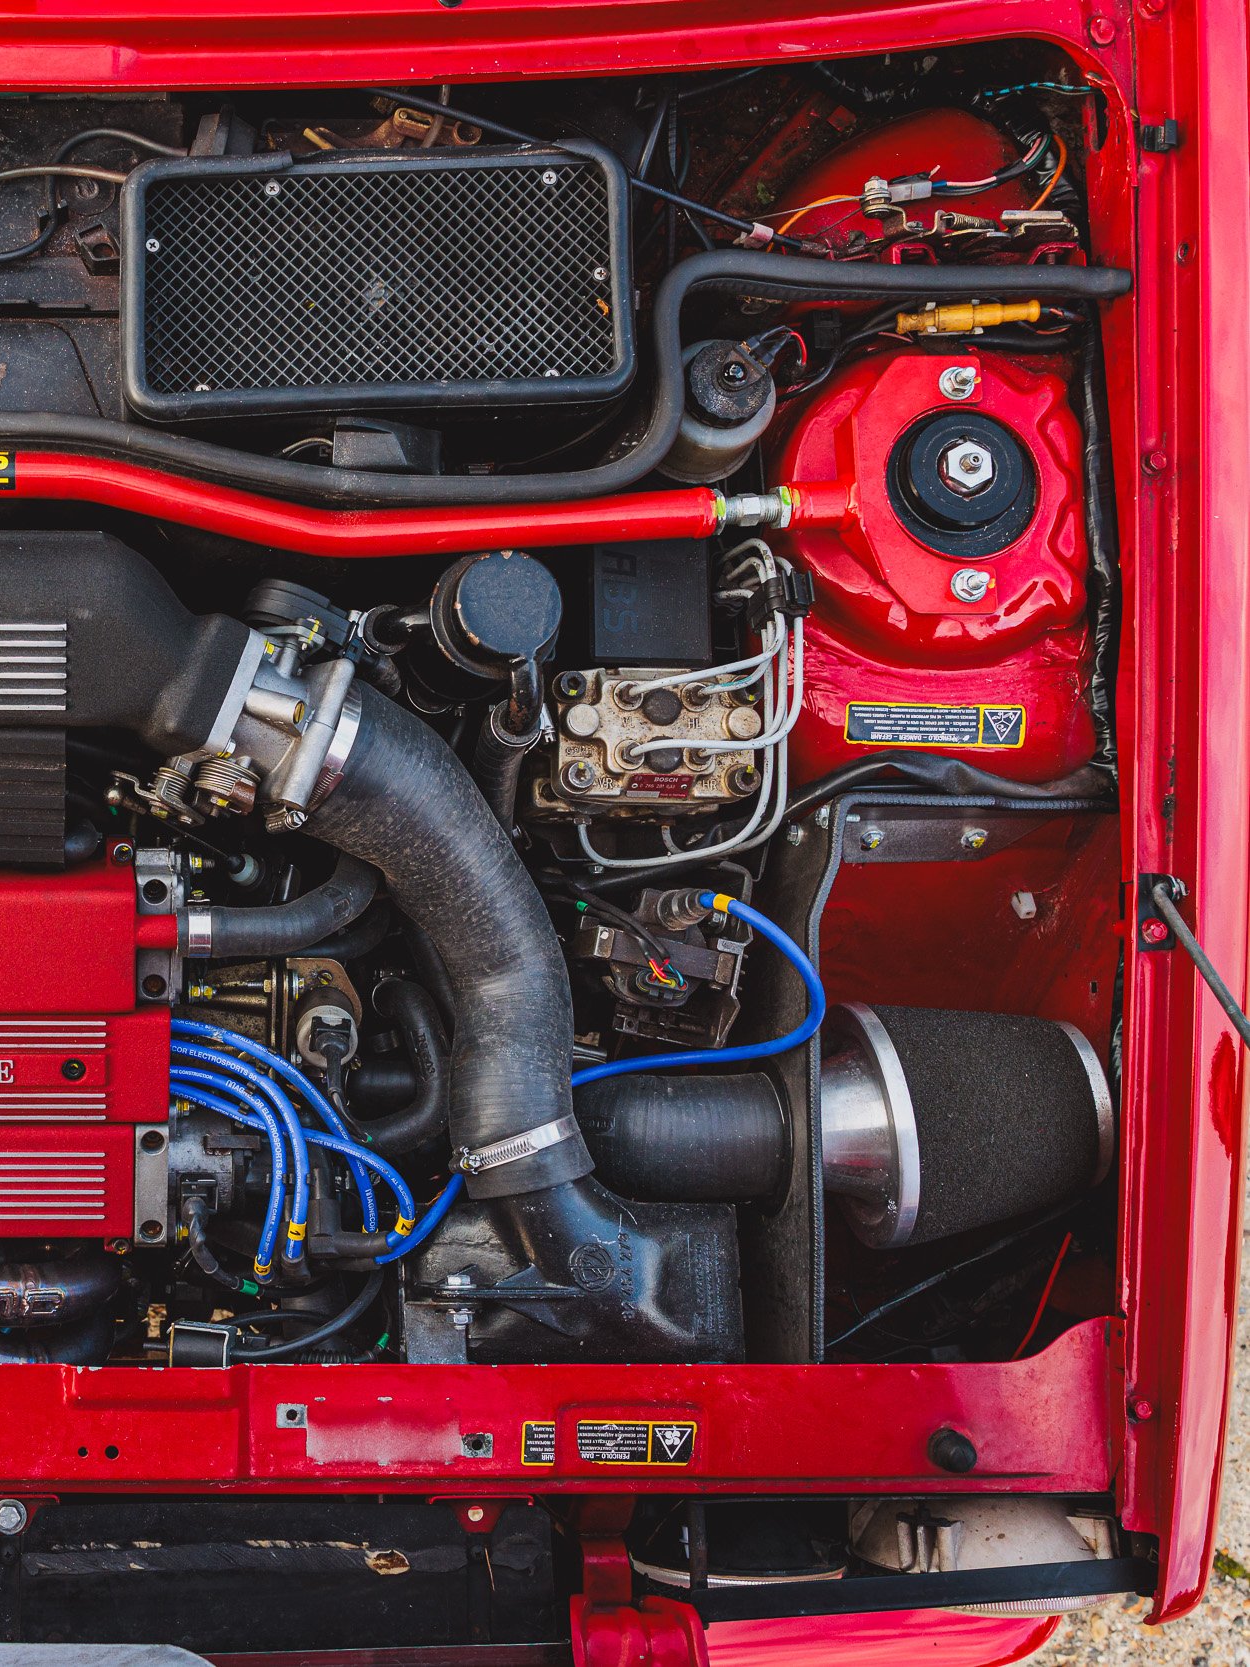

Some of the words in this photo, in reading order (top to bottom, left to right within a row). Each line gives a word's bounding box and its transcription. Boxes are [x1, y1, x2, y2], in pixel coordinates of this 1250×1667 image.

[603, 551, 638, 634] ABS
[701, 780, 717, 791] HR
[189, 1048, 249, 1077] ELECTROSPORTS
[178, 1069, 214, 1080] CONSTRUCTION
[261, 1106, 284, 1169] ELECTROSPORTS
[275, 1171, 283, 1180] 80
[364, 1188, 376, 1232] MAGNECOR
